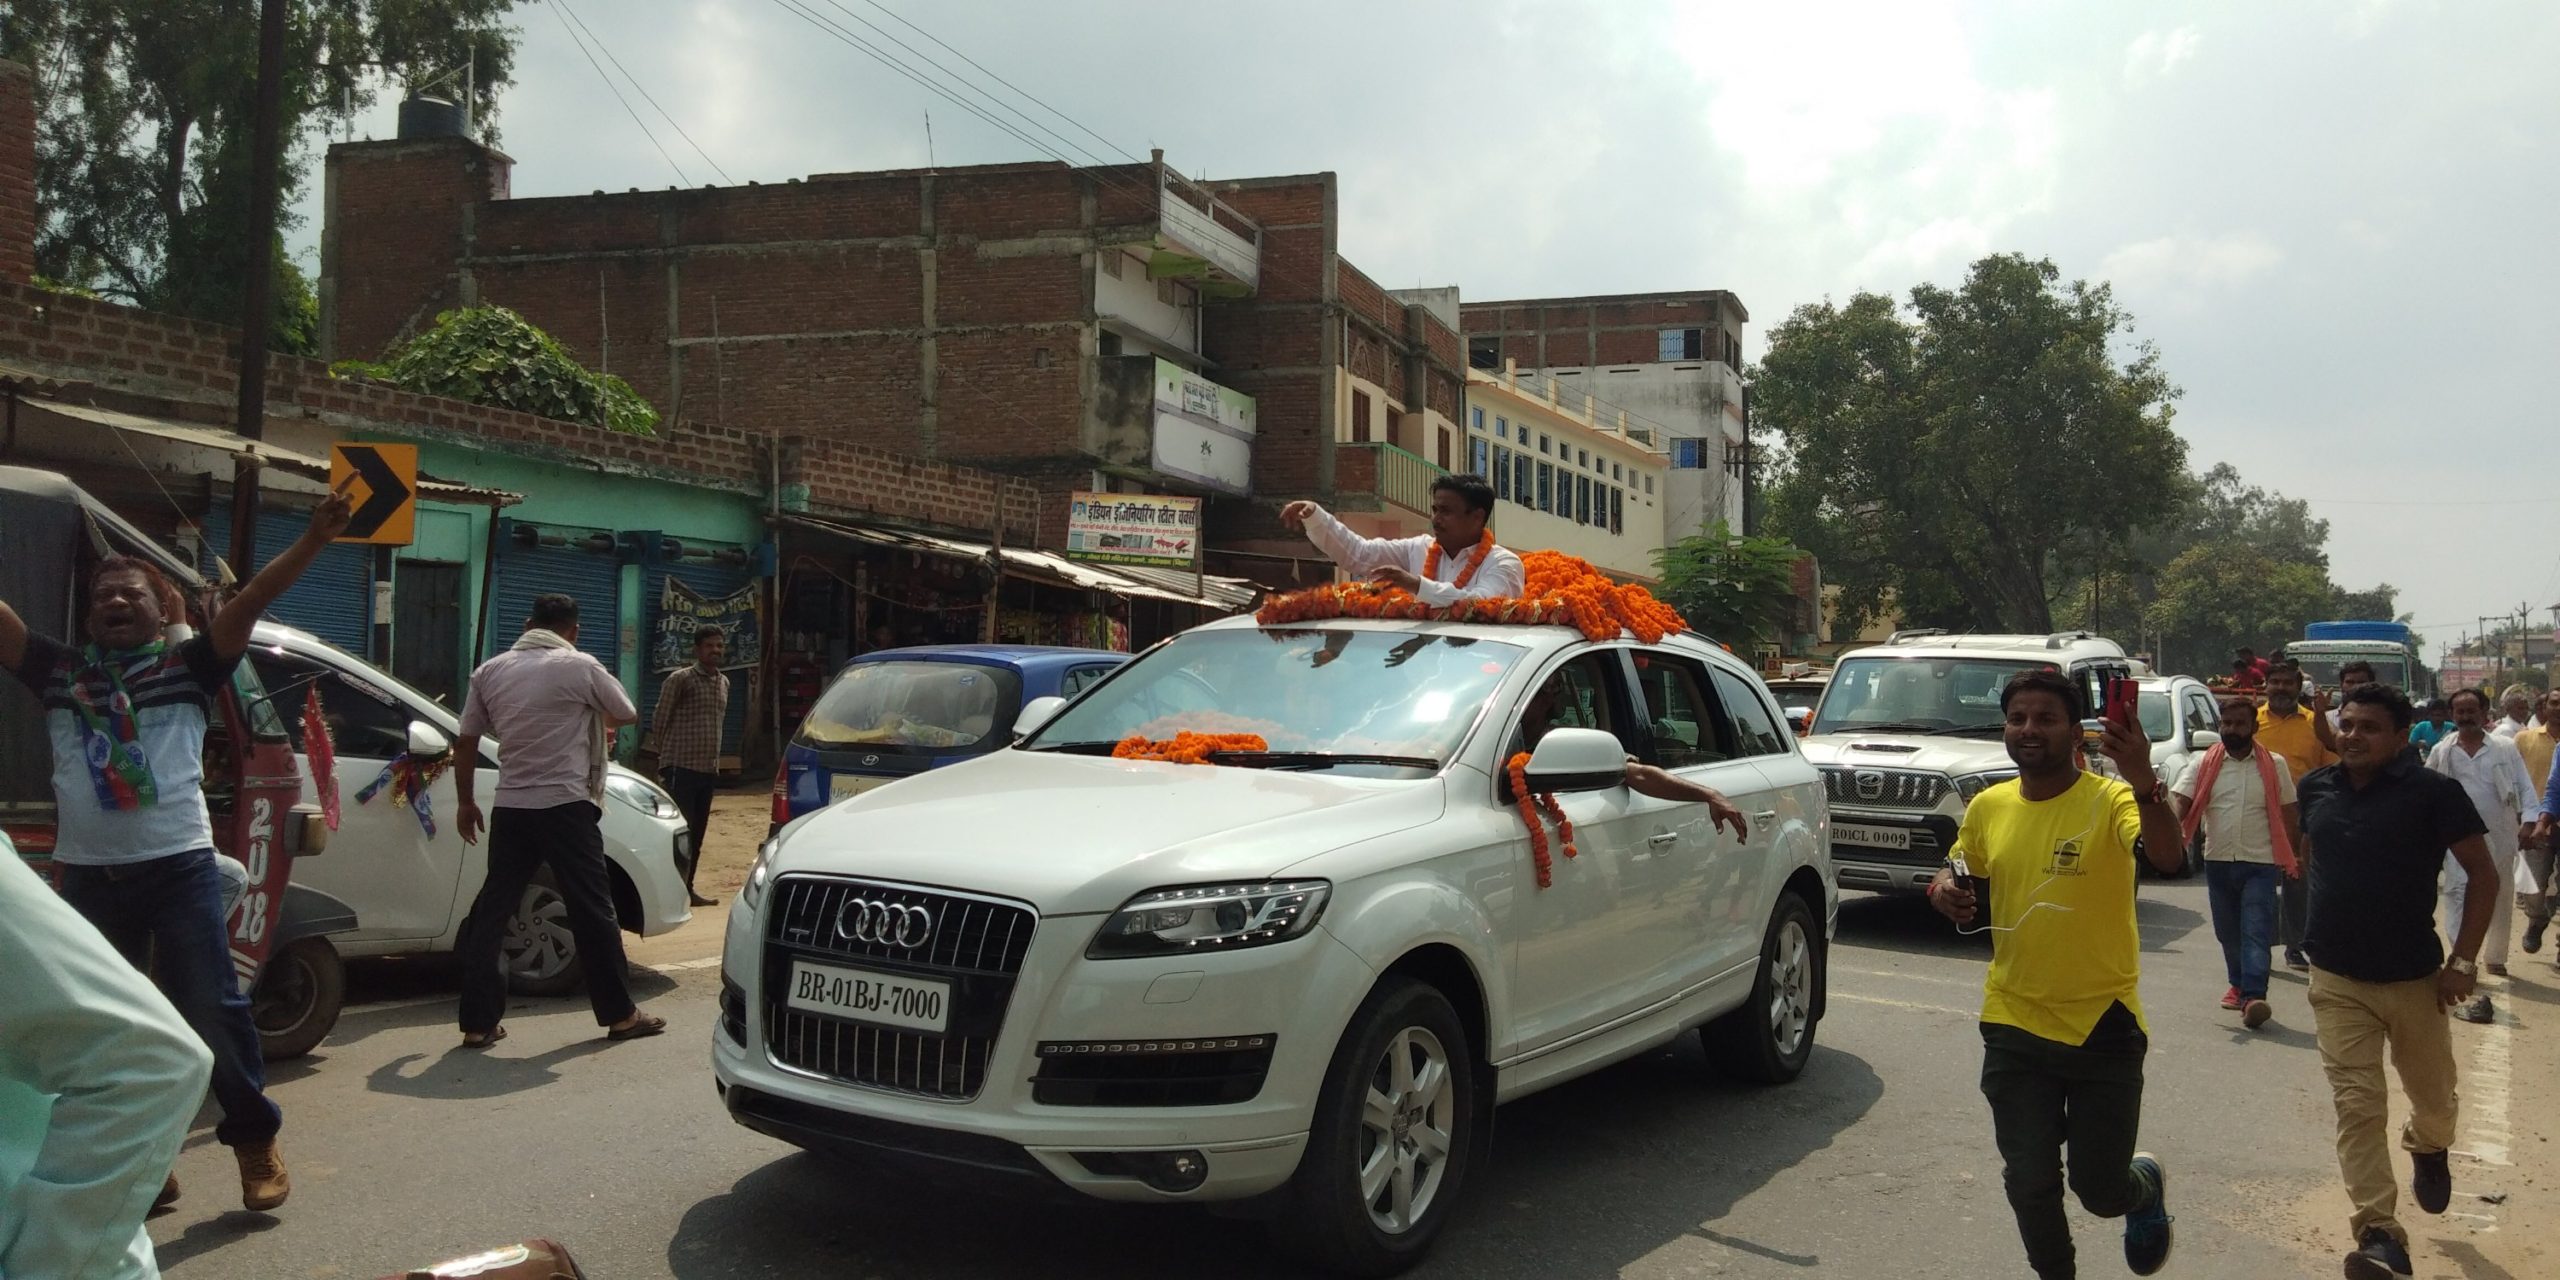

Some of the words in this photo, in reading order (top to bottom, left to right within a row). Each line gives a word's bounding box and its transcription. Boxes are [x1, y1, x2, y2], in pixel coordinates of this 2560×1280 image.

[1088, 501, 1112, 520] इंडियन
[1158, 505, 1176, 524] स्टील
[796, 970, 941, 1020] BR-01BJ-7000
